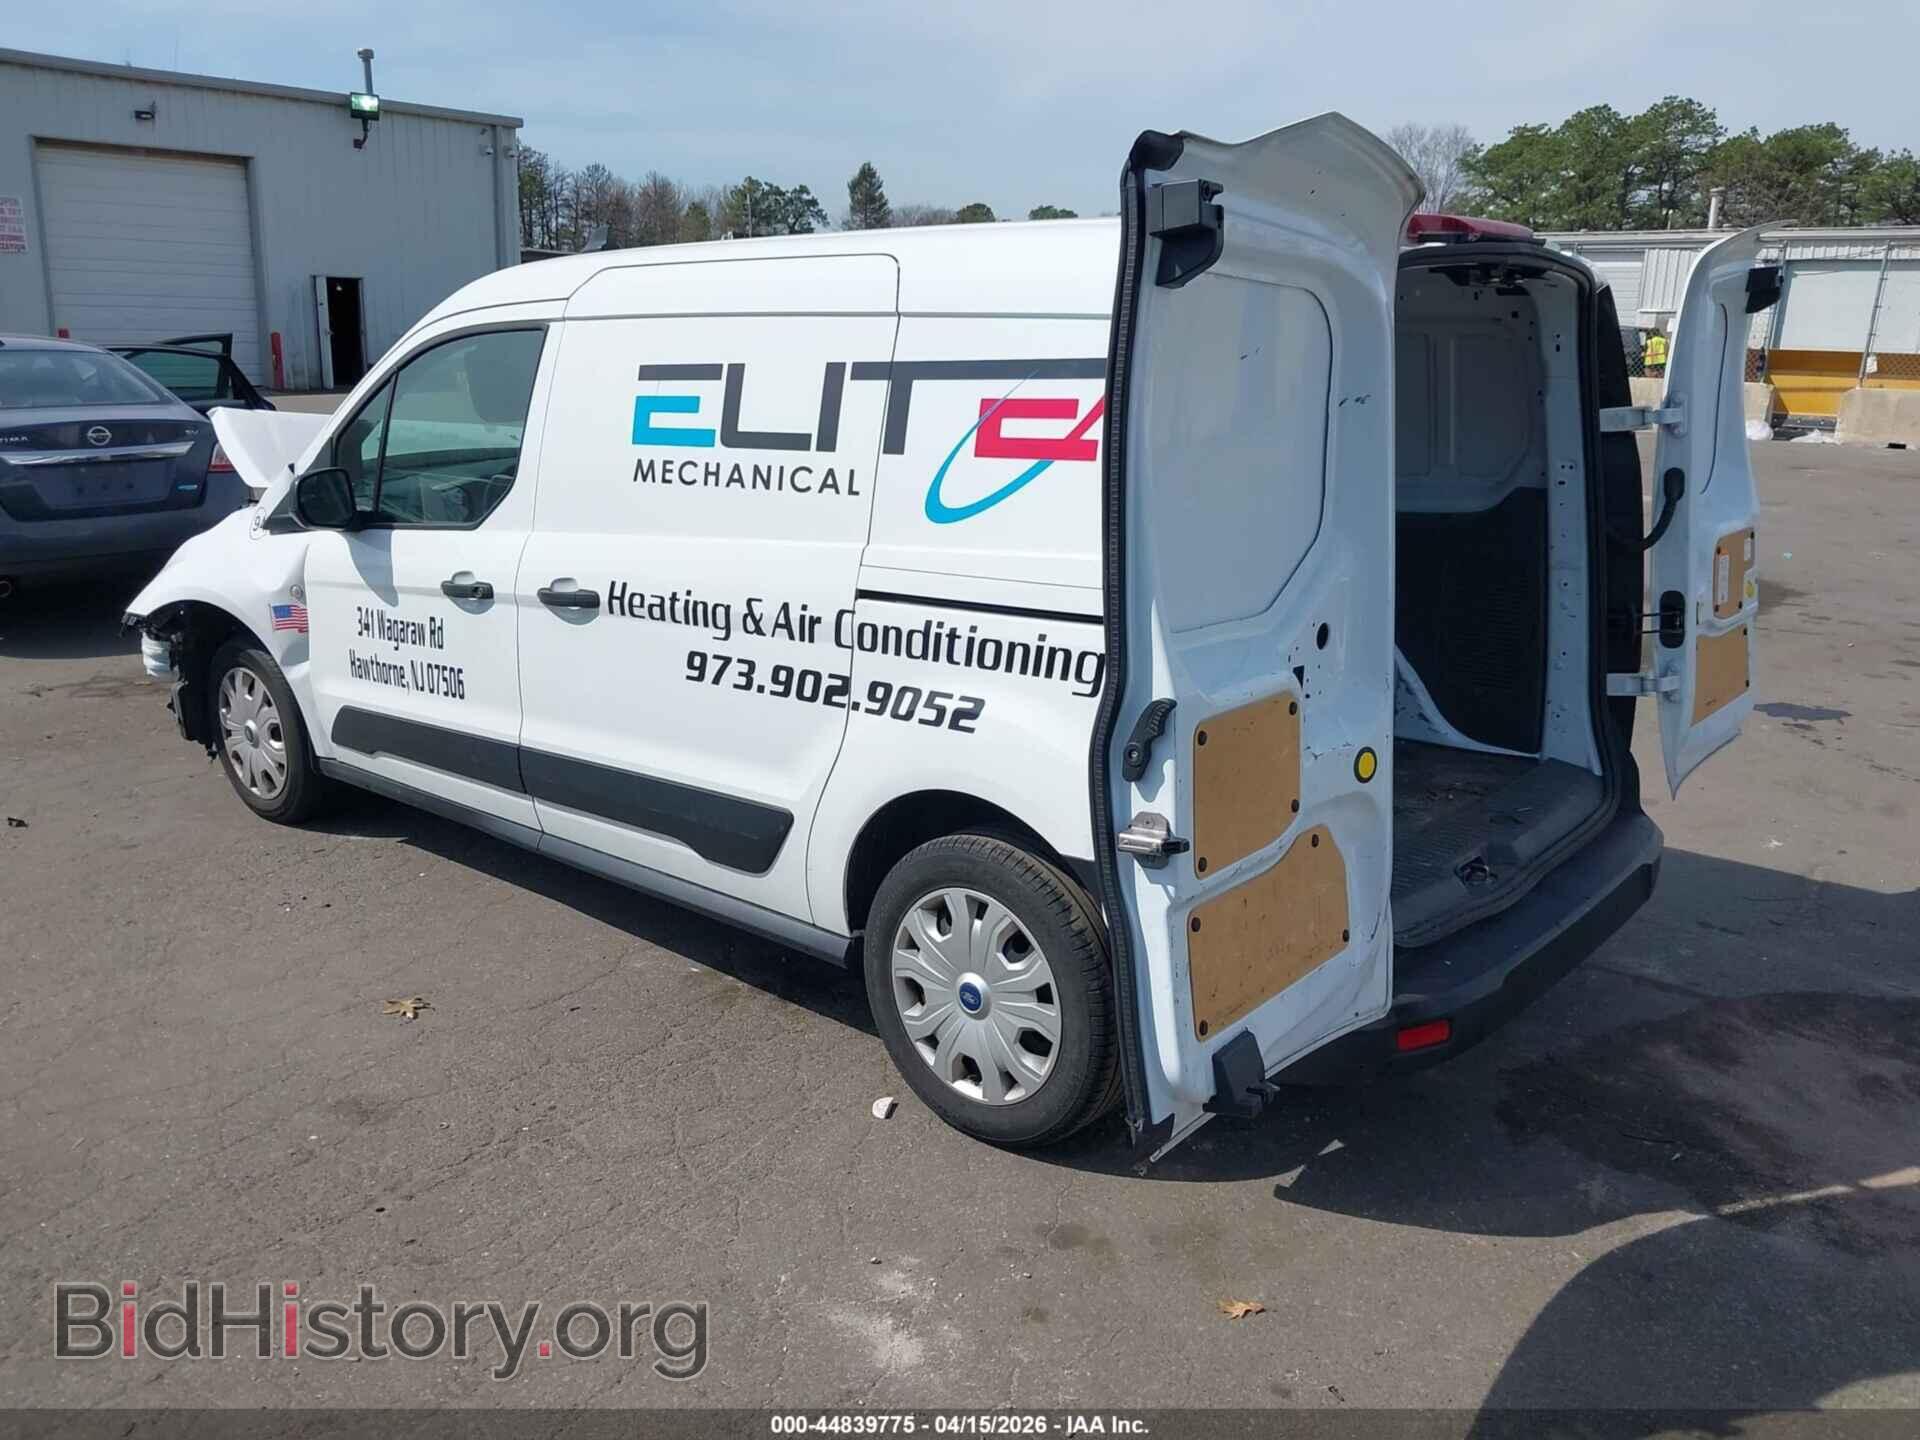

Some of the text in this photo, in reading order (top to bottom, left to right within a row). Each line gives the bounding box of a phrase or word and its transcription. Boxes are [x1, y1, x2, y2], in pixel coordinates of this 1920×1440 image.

[633, 458, 860, 496] MECHANICAL
[357, 606, 444, 651] 341 Wagaraw Rd
[608, 580, 732, 641] Heating
[771, 602, 822, 643] Air
[834, 609, 1106, 698] Conditioning
[349, 648, 465, 700] Hawthorne, NJ 07506
[686, 650, 986, 734] 973.902.9052
